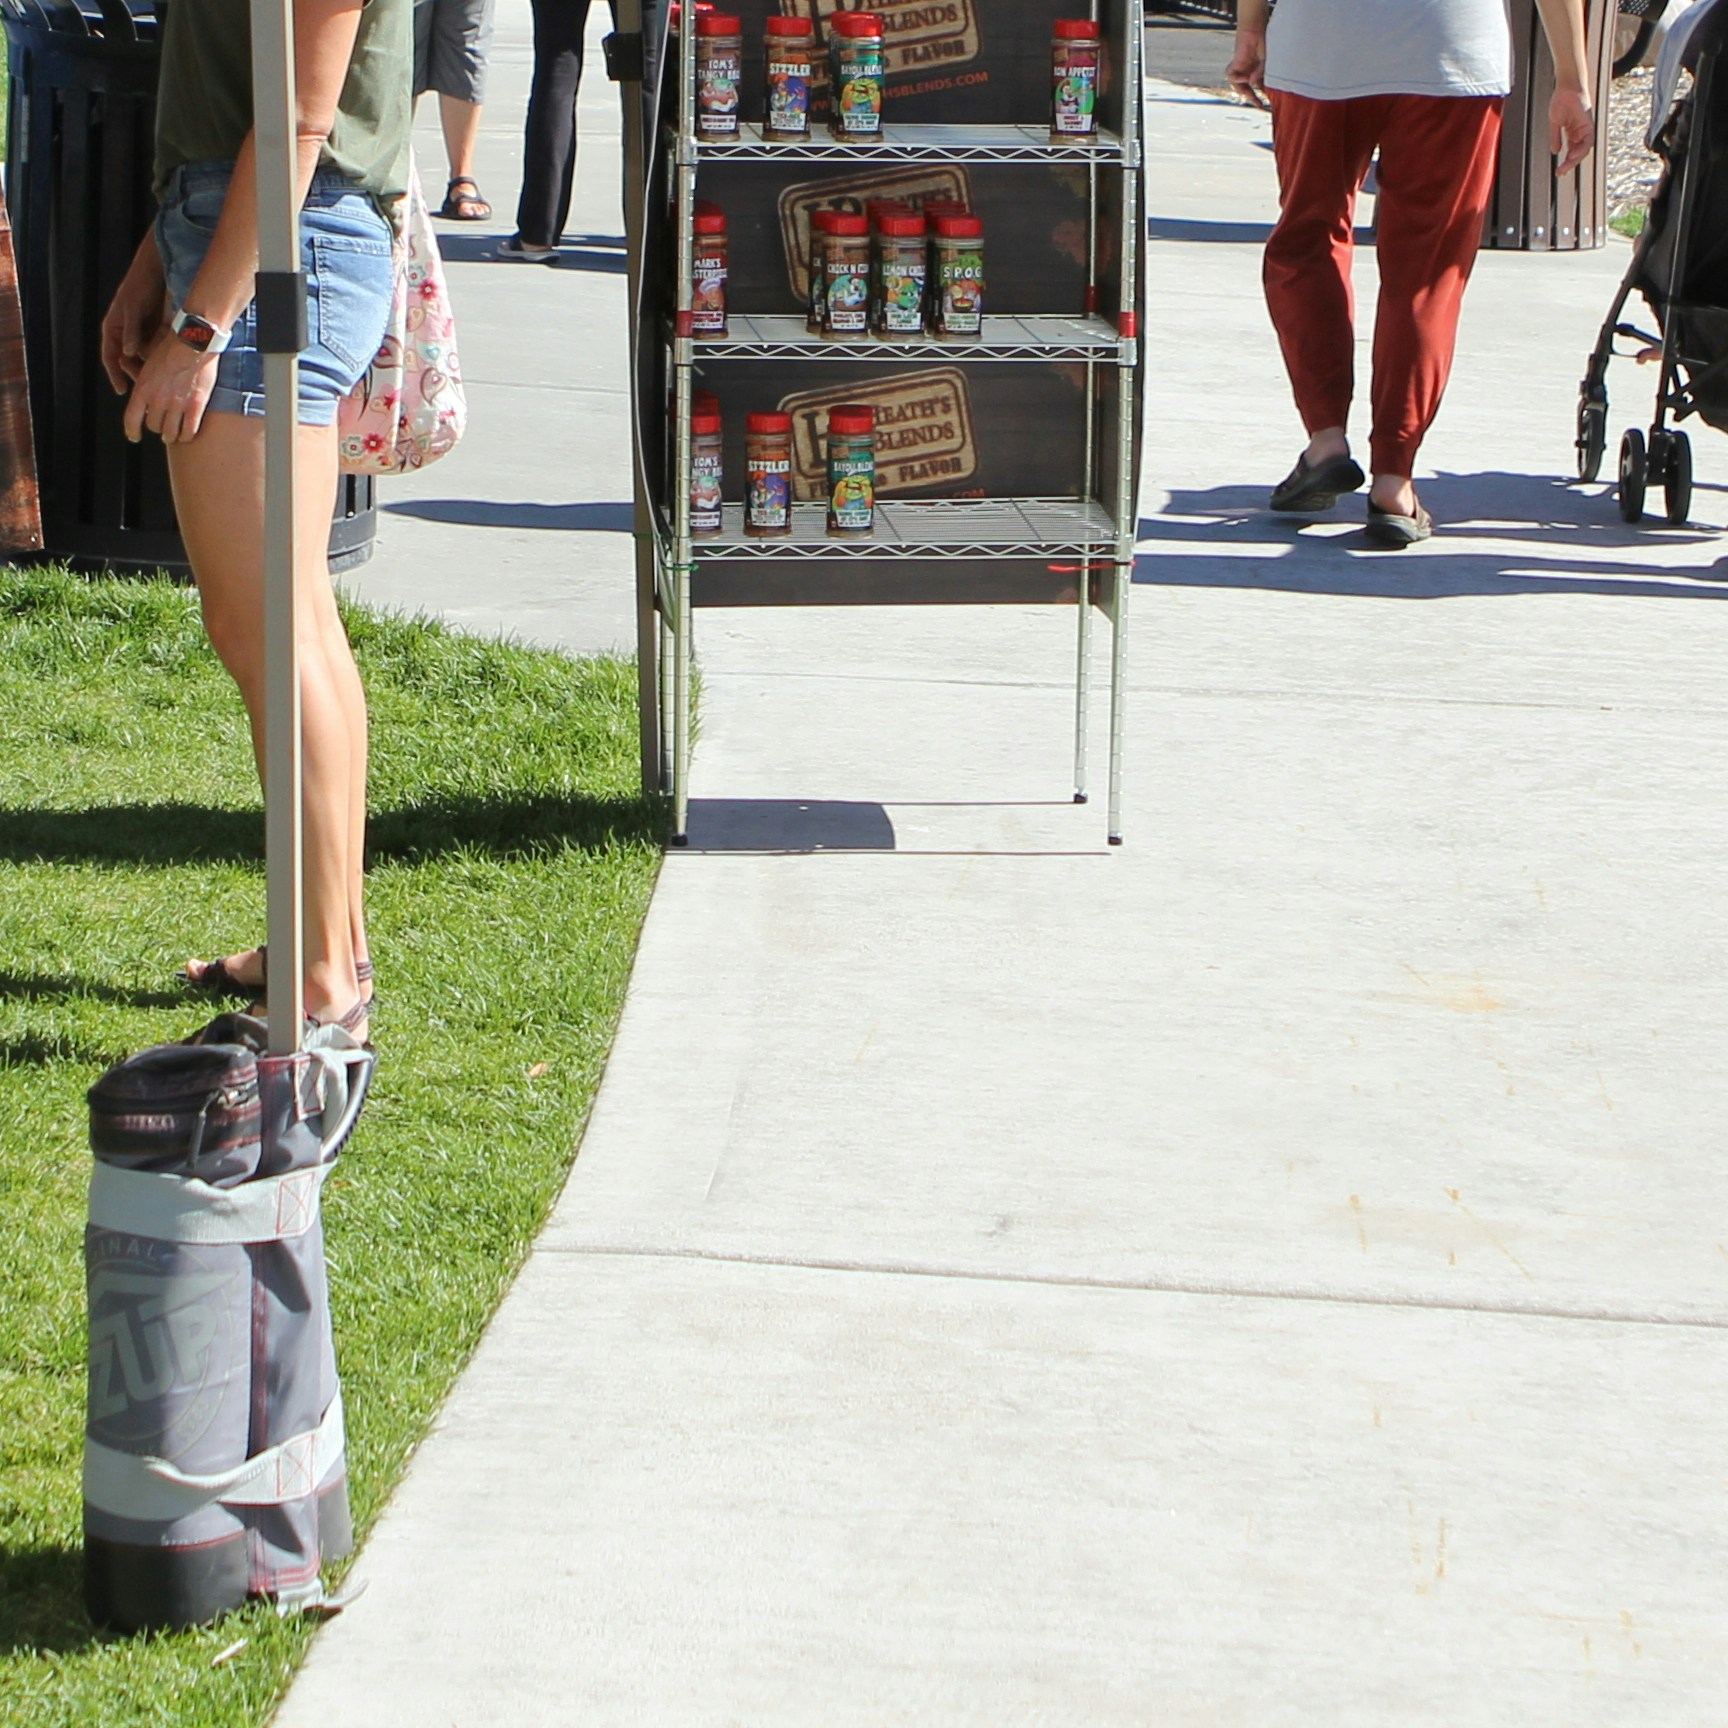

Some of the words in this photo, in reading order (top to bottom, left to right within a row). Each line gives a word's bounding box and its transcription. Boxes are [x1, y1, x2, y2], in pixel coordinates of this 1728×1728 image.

[902, 40, 966, 64] FLAVOR
[770, 62, 811, 76] SIZZLER
[872, 396, 952, 423] HEATH'S
[874, 421, 955, 452] BLENDS
[748, 460, 789, 472] SIZZLER
[899, 458, 962, 482] FLAVOR
